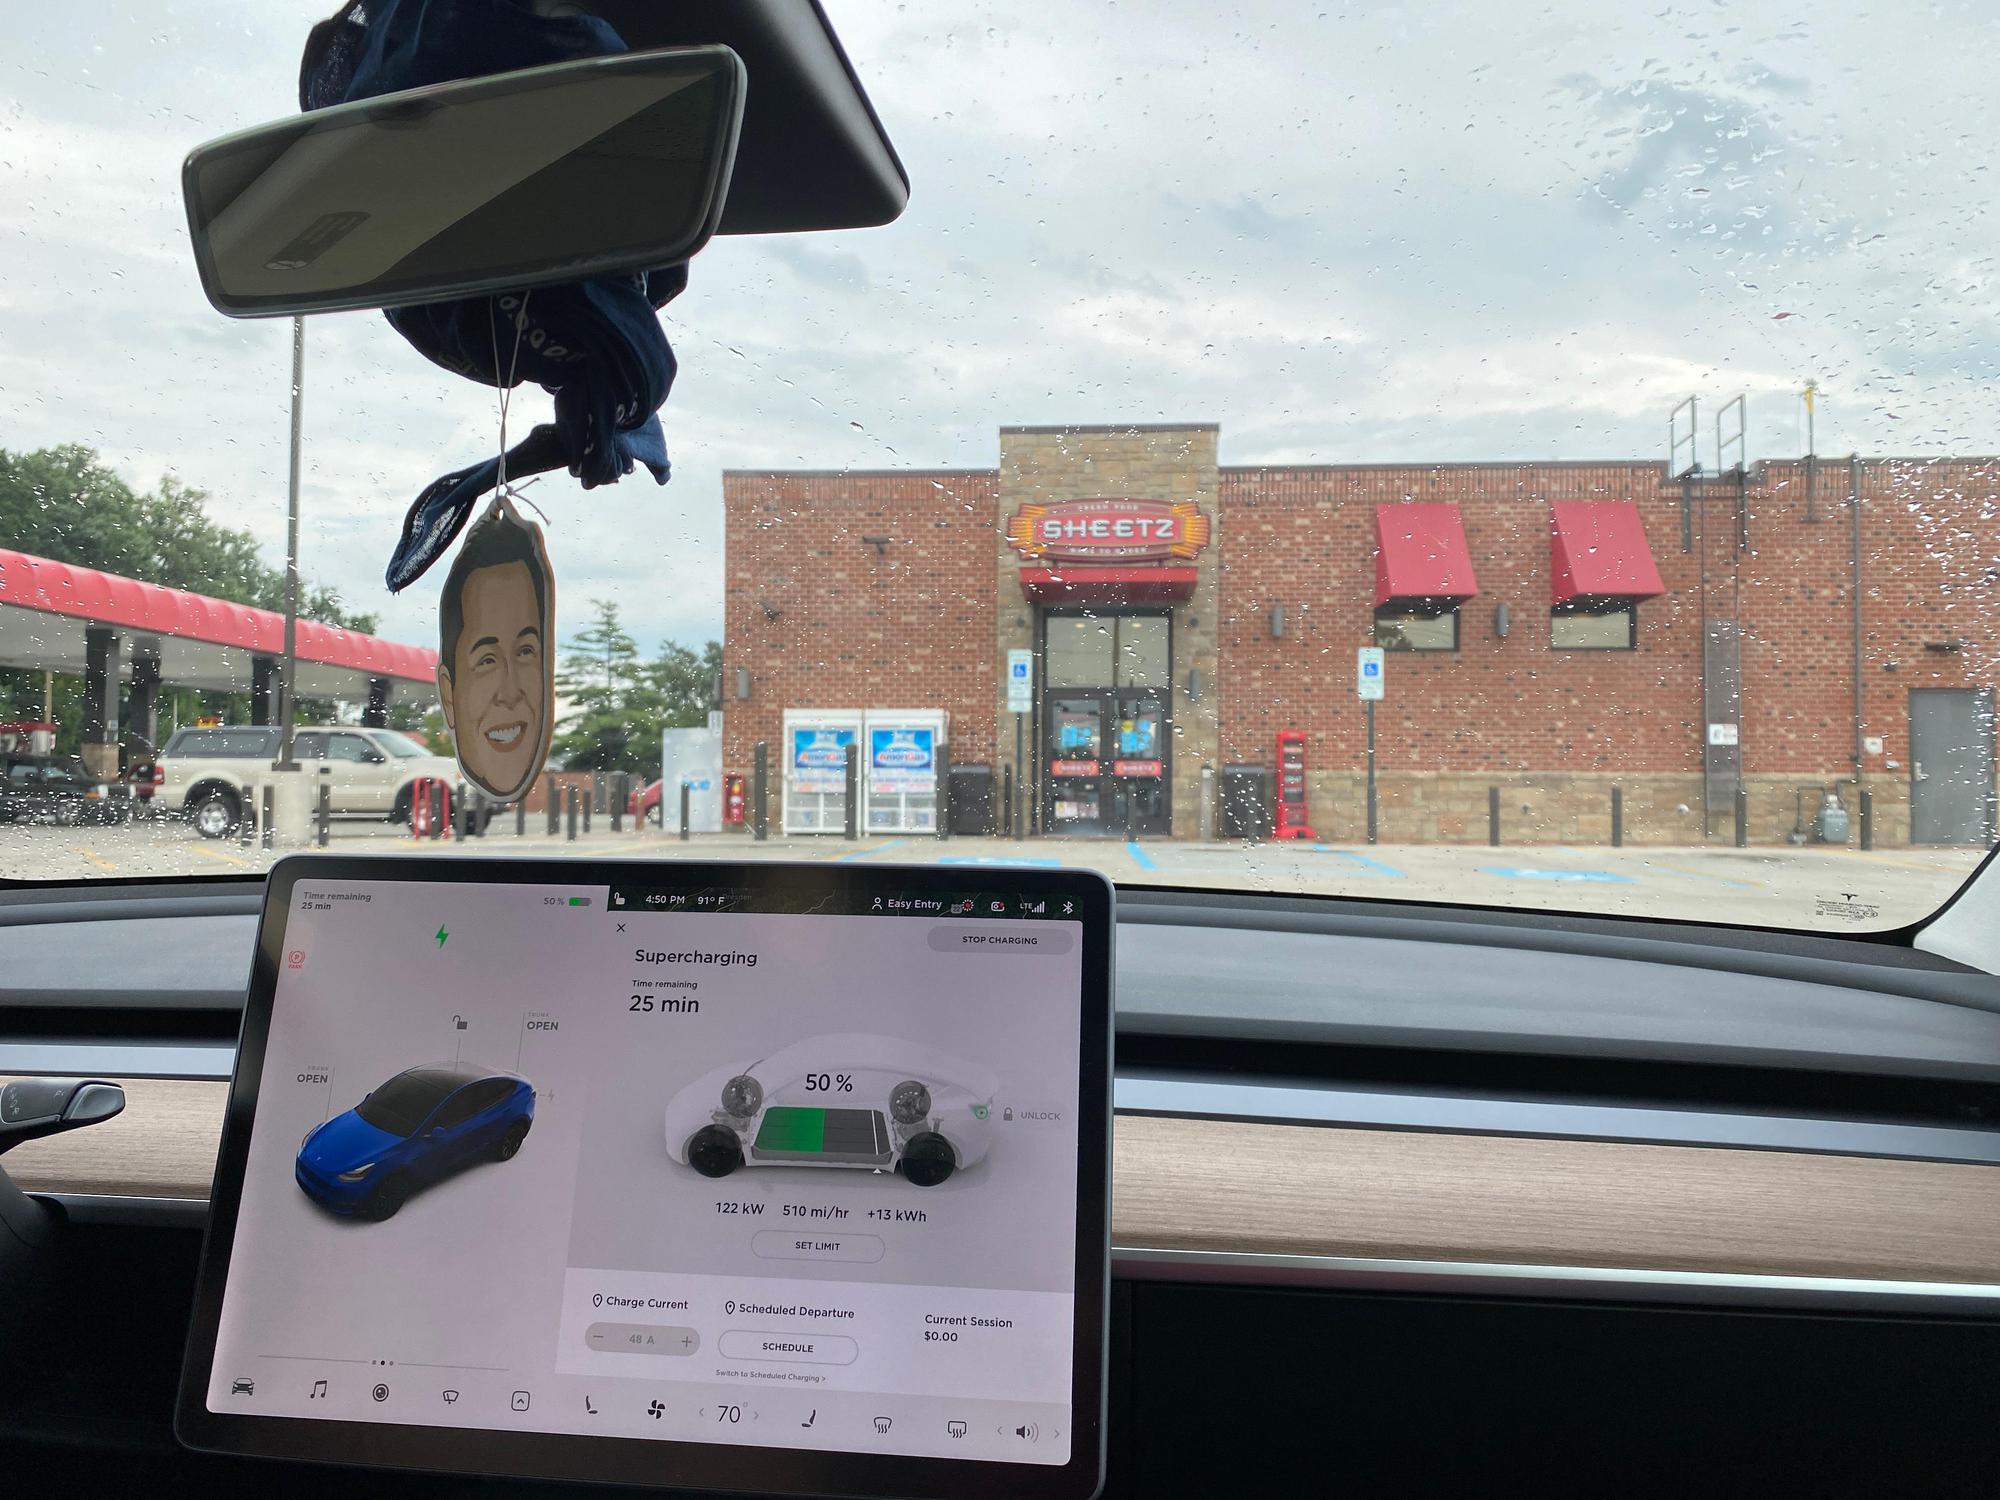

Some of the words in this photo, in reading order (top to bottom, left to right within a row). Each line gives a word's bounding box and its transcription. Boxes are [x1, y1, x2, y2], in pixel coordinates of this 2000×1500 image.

[1043, 519, 1174, 539] SHEETZ
[304, 890, 326, 901] Time
[326, 892, 372, 903] remaining
[544, 897, 556, 906] 50
[646, 894, 666, 904] 4:50
[670, 895, 686, 904] PM
[718, 896, 724, 905] F
[302, 901, 312, 910] 25
[314, 902, 332, 911] min
[886, 898, 912, 911] Easy
[914, 899, 942, 912] Entry
[1018, 902, 1032, 910] LTE
[962, 935, 986, 944] STOP
[988, 936, 1038, 945] CHARGING
[635, 949, 757, 967] Supercharging
[632, 979, 652, 988] Time
[654, 980, 698, 991] remaining
[629, 995, 654, 1012] 25
[662, 996, 699, 1012] min
[526, 1020, 558, 1031] OPEN
[296, 1073, 328, 1084] OPEN
[806, 1074, 830, 1091] 50
[836, 1075, 852, 1092] %
[1020, 1111, 1060, 1121] UNLOCK
[716, 1202, 738, 1214] 122
[742, 1202, 764, 1215] kW
[782, 1204, 806, 1217] 510
[811, 1206, 849, 1219] mi/hr
[868, 1208, 892, 1221] +13
[896, 1210, 926, 1222] kWh
[796, 1241, 812, 1250] SET
[816, 1242, 840, 1251] LIMIT
[606, 1296, 644, 1309] Charge
[648, 1298, 688, 1310] Current
[738, 1303, 796, 1316] Scheduled
[800, 1306, 854, 1319] Departure
[924, 1314, 968, 1326] Current
[970, 1316, 1012, 1328] Session
[628, 1334, 642, 1344] 48
[646, 1335, 654, 1345] A
[924, 1330, 958, 1342] $0.00
[762, 1342, 814, 1353] SCHEDULE
[716, 1369, 740, 1377] Switch
[740, 1370, 748, 1378] to
[750, 1370, 786, 1380] Scheduled
[788, 1372, 820, 1384] Charging
